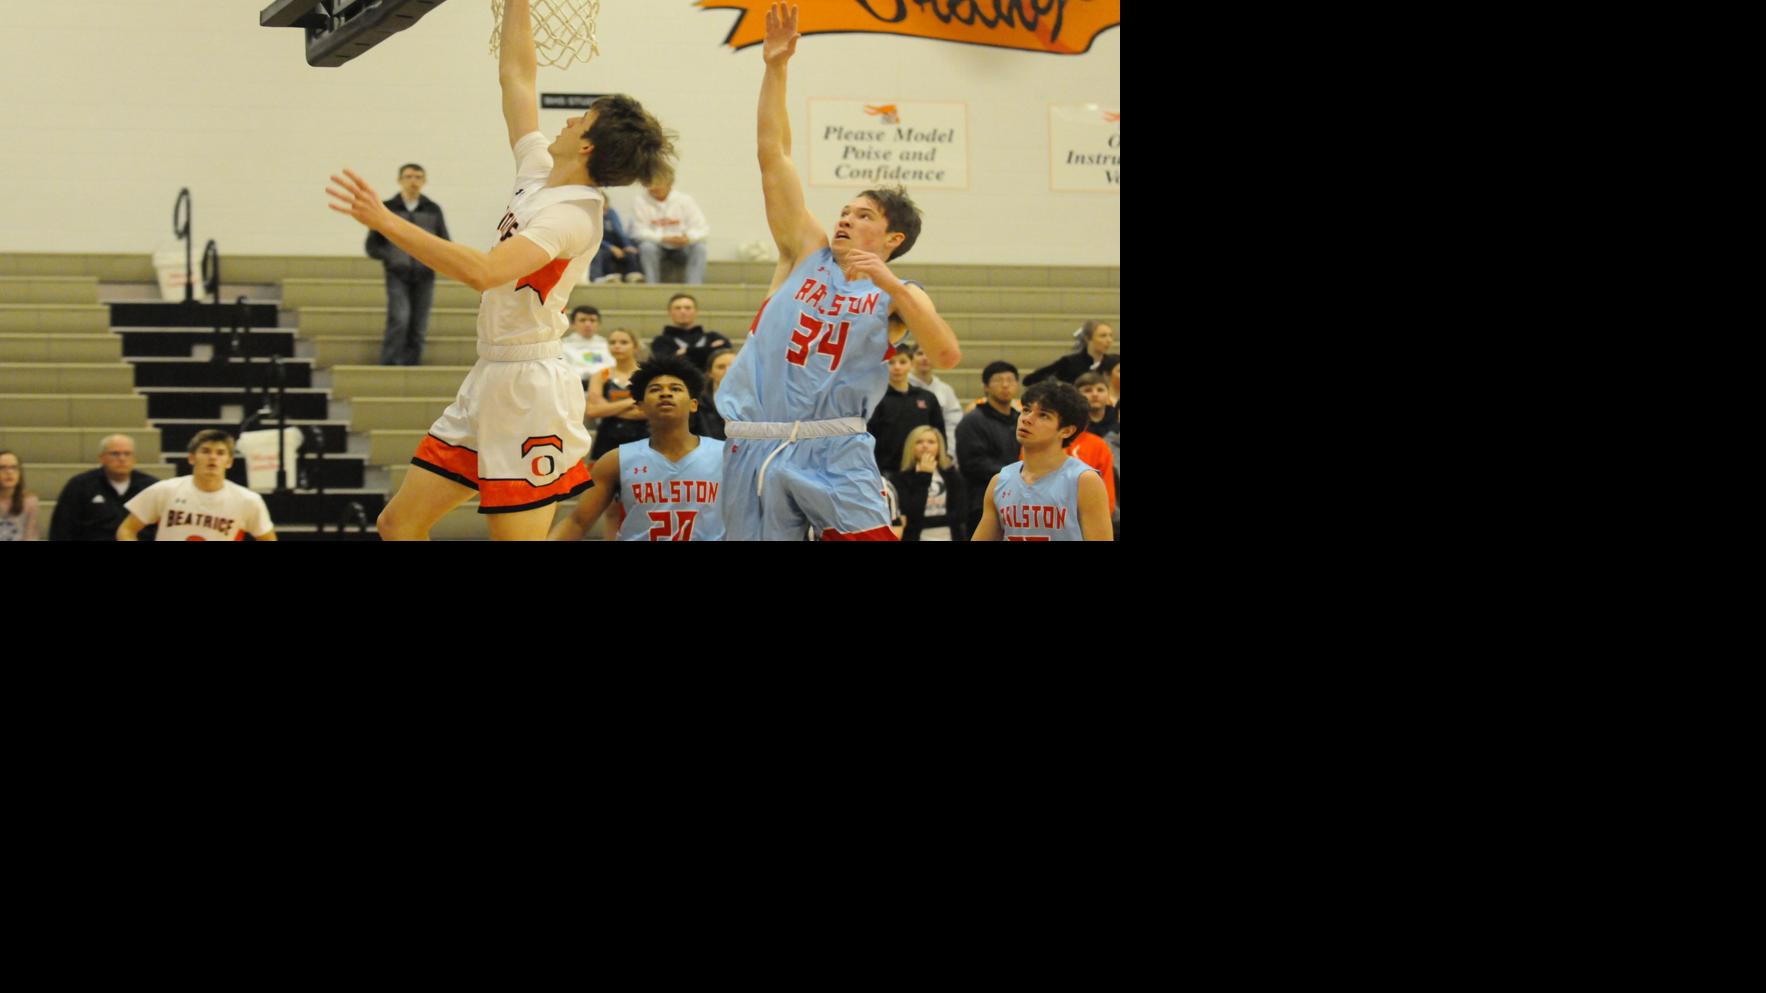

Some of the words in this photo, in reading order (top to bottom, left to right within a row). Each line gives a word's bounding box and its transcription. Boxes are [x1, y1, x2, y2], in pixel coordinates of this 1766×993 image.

[823, 125, 886, 142] Please
[894, 127, 955, 144] Model
[842, 144, 893, 161] Poise
[898, 146, 937, 162] and
[834, 163, 945, 183] Confidence
[785, 310, 850, 373] 34
[632, 480, 719, 504] RALSTON
[166, 509, 235, 534] BEATRICE
